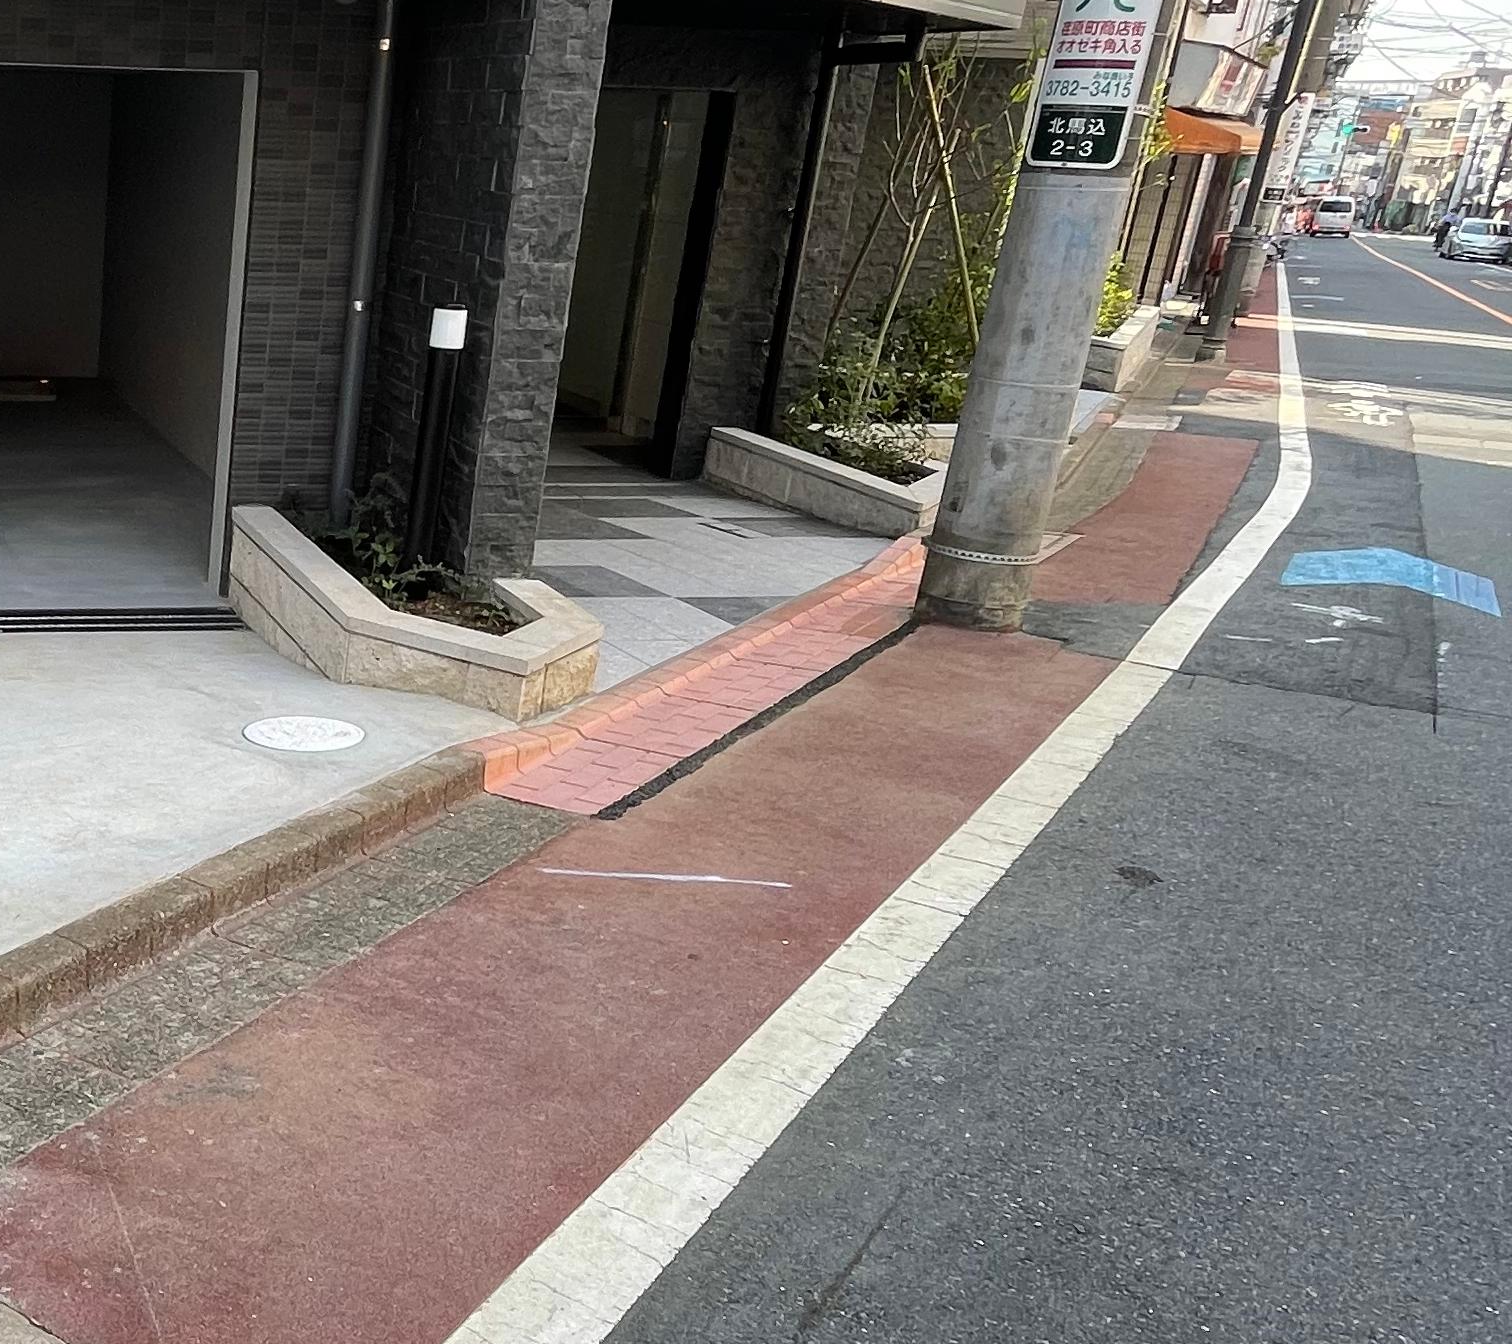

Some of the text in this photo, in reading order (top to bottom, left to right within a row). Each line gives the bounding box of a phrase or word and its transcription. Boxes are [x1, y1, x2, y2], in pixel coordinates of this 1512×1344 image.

[1056, 38, 1142, 54] オオゼキ角入る
[1046, 79, 1132, 98] 3782-3415
[1048, 117, 1106, 136] 北馬込
[1049, 139, 1094, 157] 2-3
